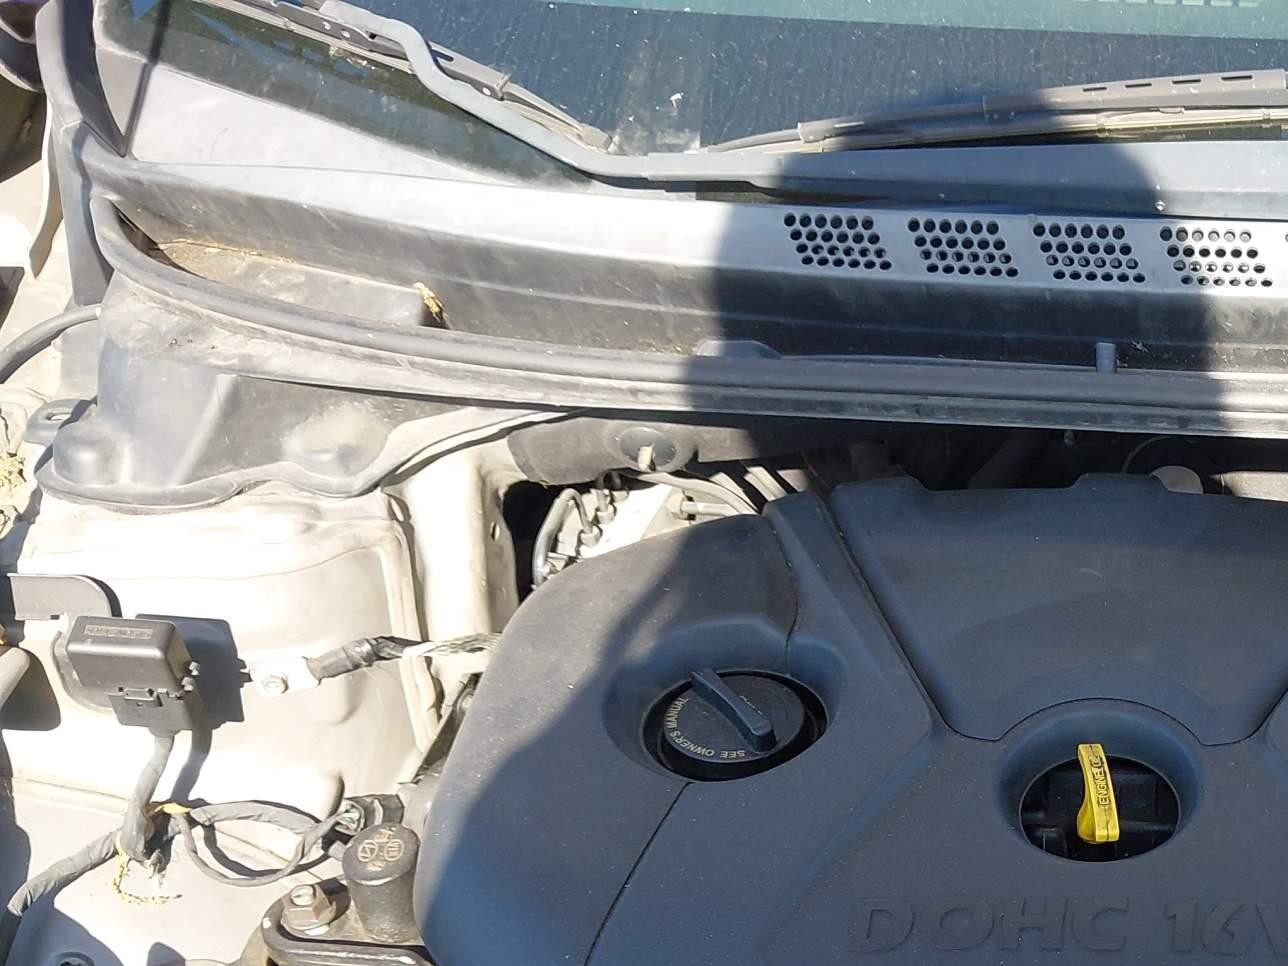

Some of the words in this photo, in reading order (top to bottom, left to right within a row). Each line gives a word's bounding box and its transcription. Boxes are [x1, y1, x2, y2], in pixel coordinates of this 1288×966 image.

[666, 696, 689, 730] MANUAL
[670, 730, 715, 757] OWNER'S
[719, 749, 746, 759] SEE
[1094, 770, 1110, 806] ENGINE
[846, 895, 1130, 953] DOHC
